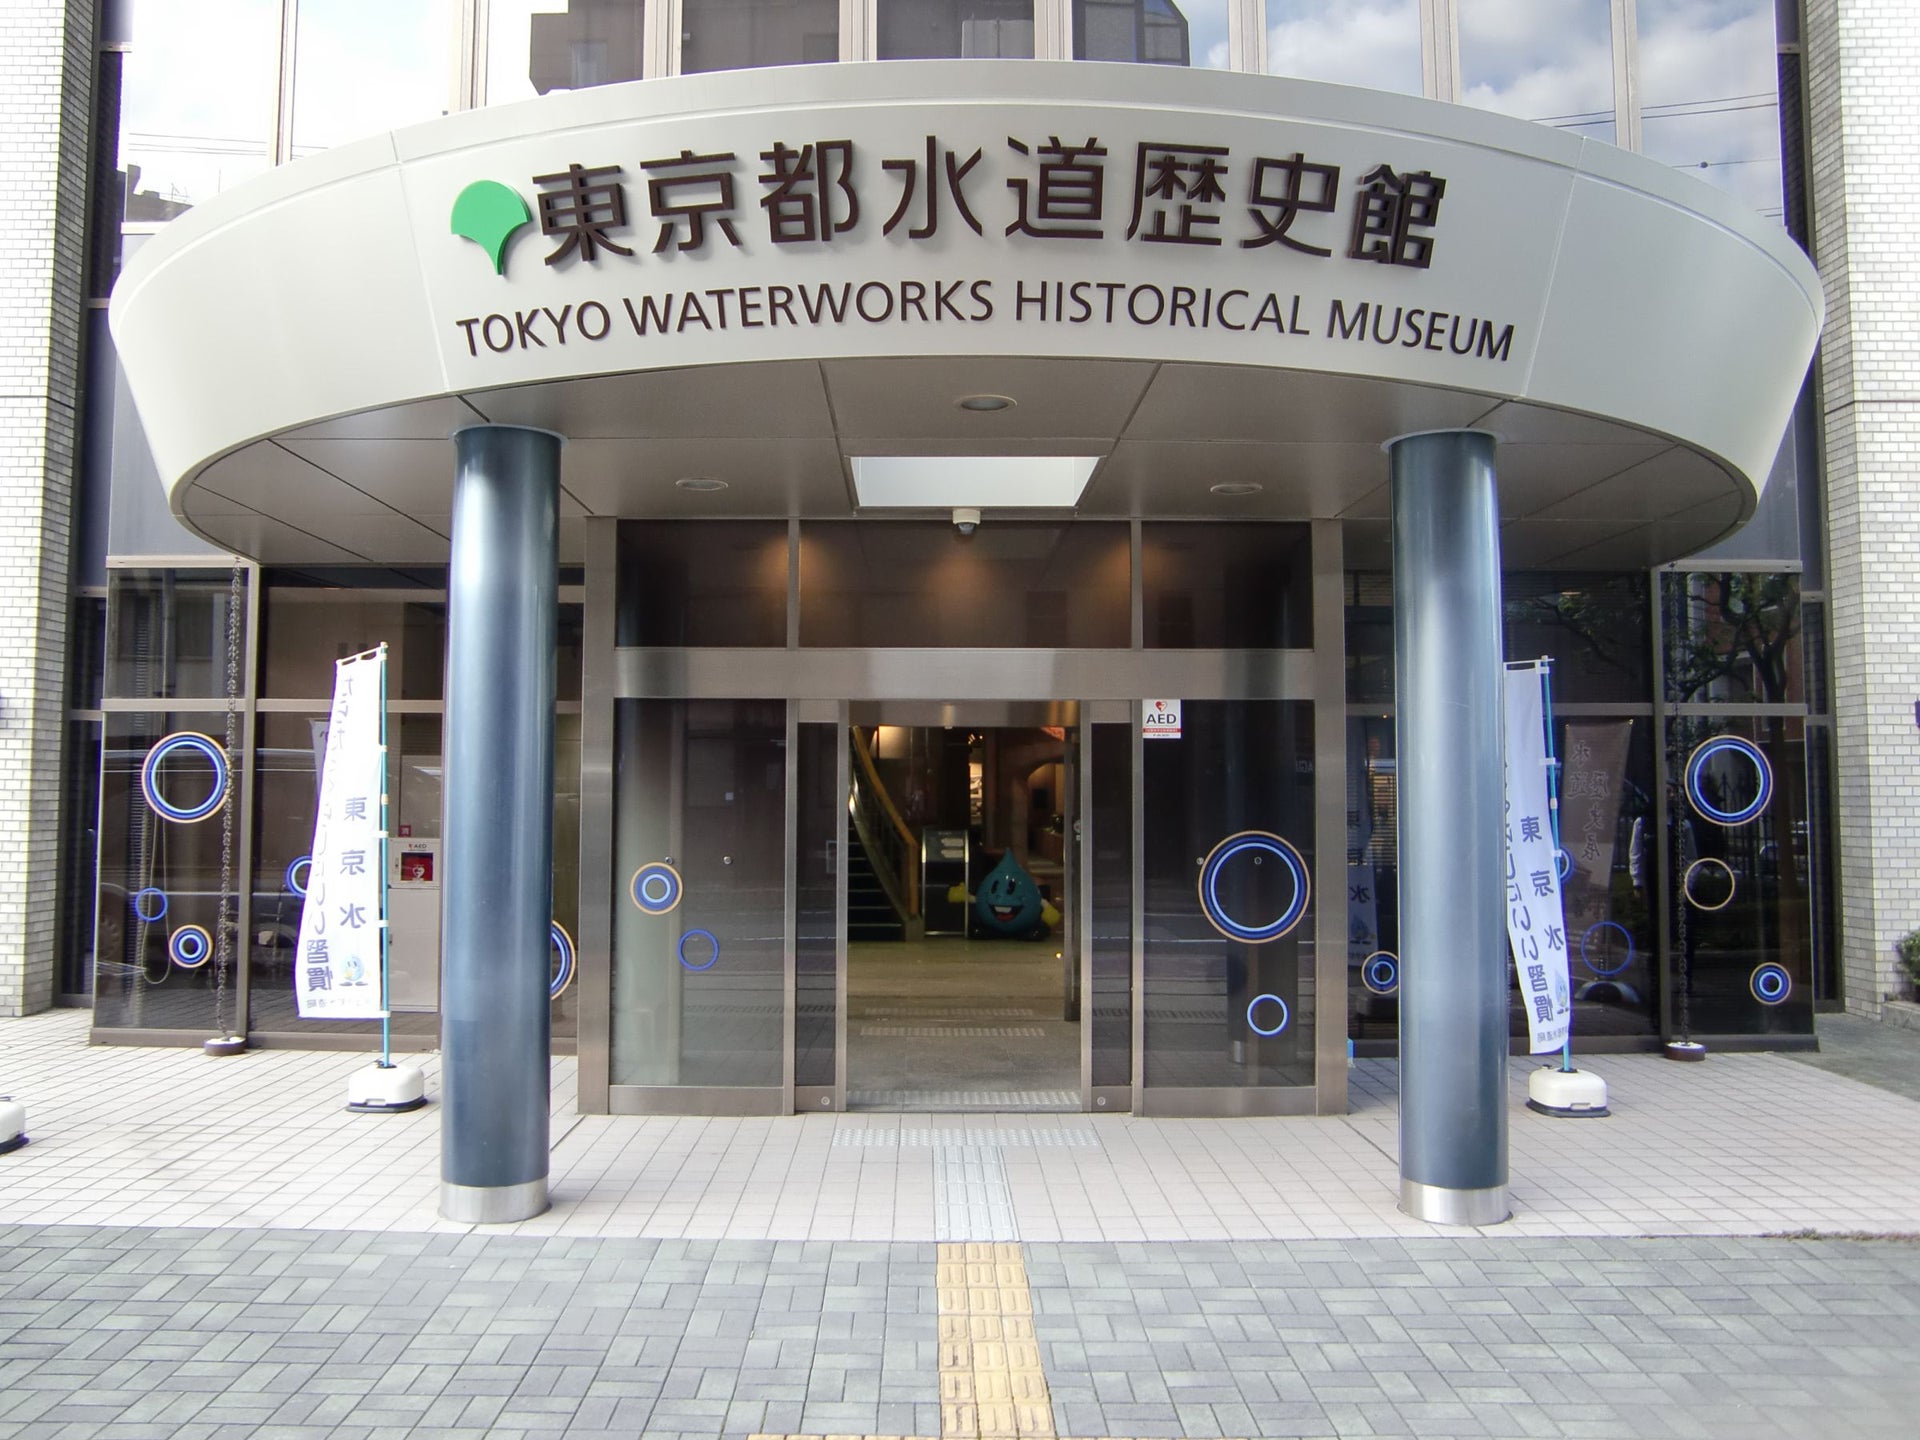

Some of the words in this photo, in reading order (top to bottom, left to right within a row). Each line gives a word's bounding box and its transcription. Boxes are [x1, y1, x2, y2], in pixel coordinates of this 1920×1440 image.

[532, 135, 1447, 269] 東京都水道歴史館
[456, 301, 611, 357] TOKYO
[622, 280, 994, 336] WATERWORKS
[1014, 280, 1310, 335] HISTORICAL
[1327, 299, 1515, 362] MUSEUM
[1146, 713, 1177, 725] AED
